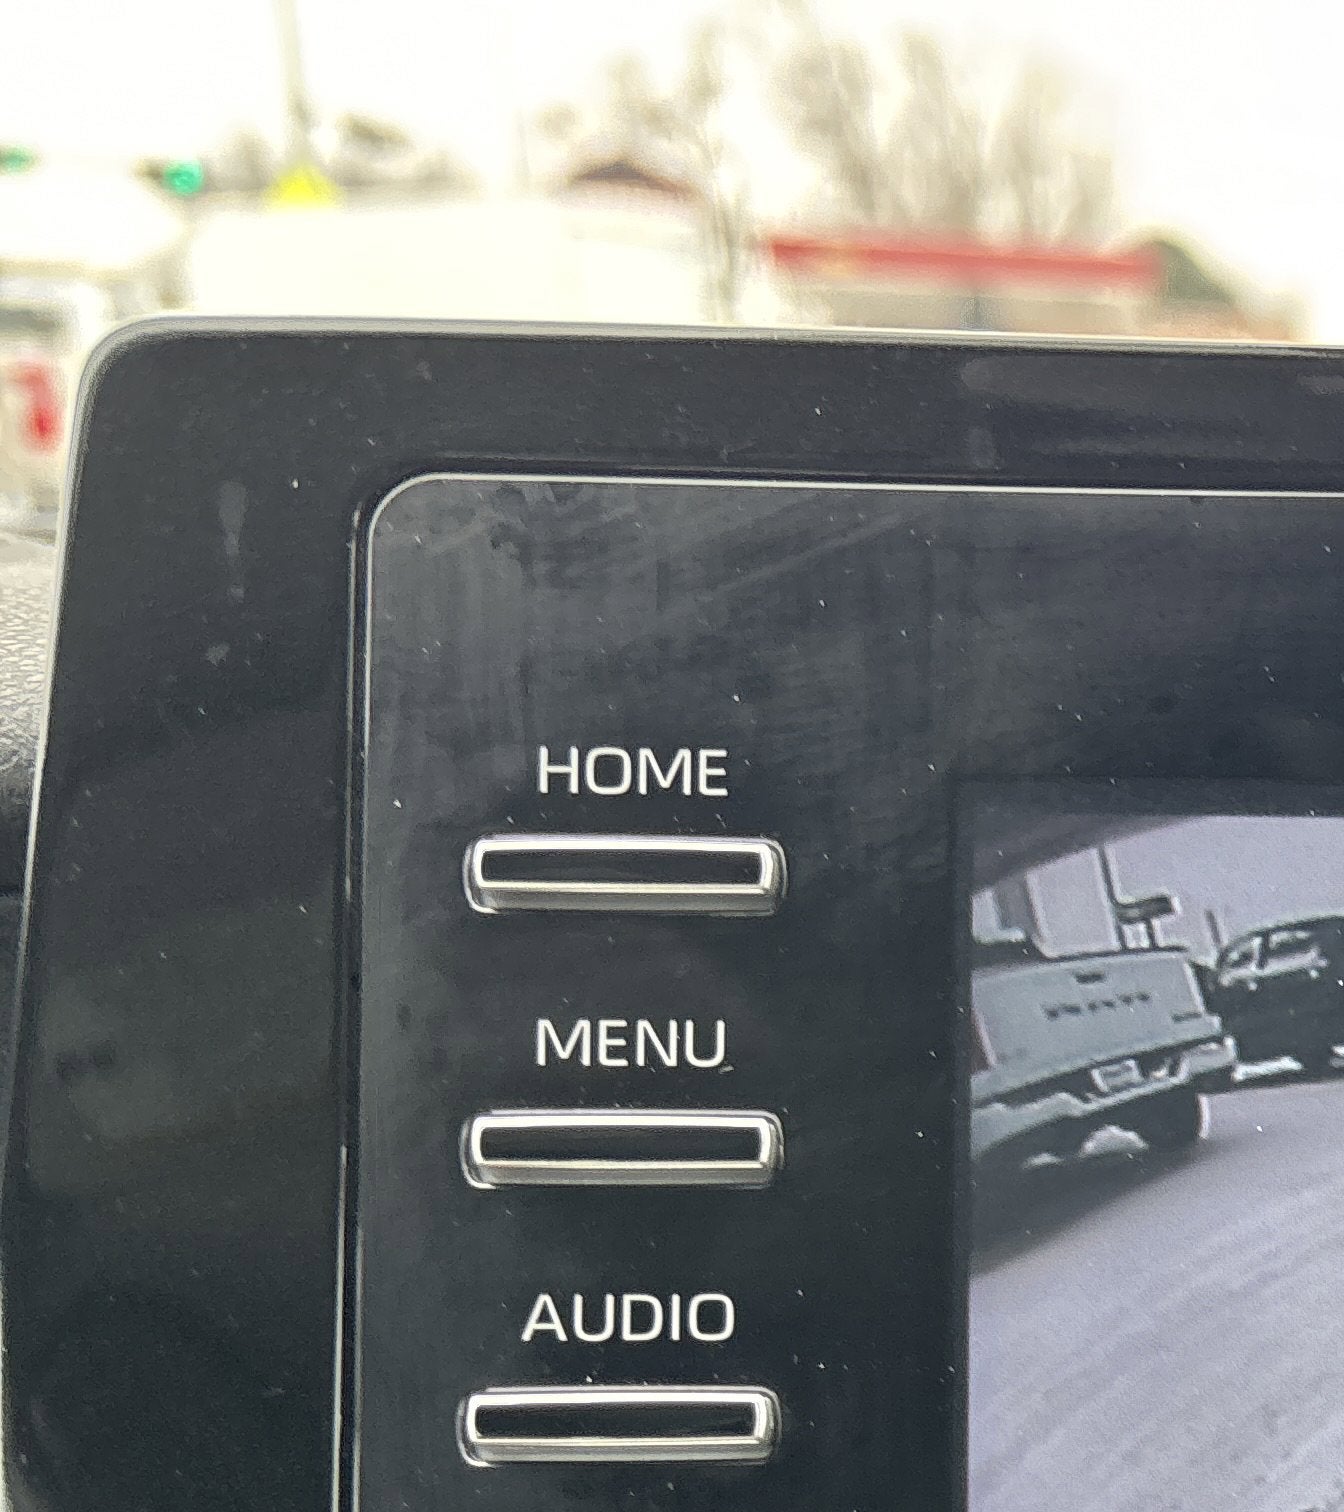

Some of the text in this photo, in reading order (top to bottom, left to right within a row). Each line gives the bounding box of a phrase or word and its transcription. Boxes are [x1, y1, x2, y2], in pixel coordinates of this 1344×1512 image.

[537, 744, 729, 798] HOME
[535, 1017, 727, 1068] MENU
[520, 1291, 736, 1343] AUDIO
